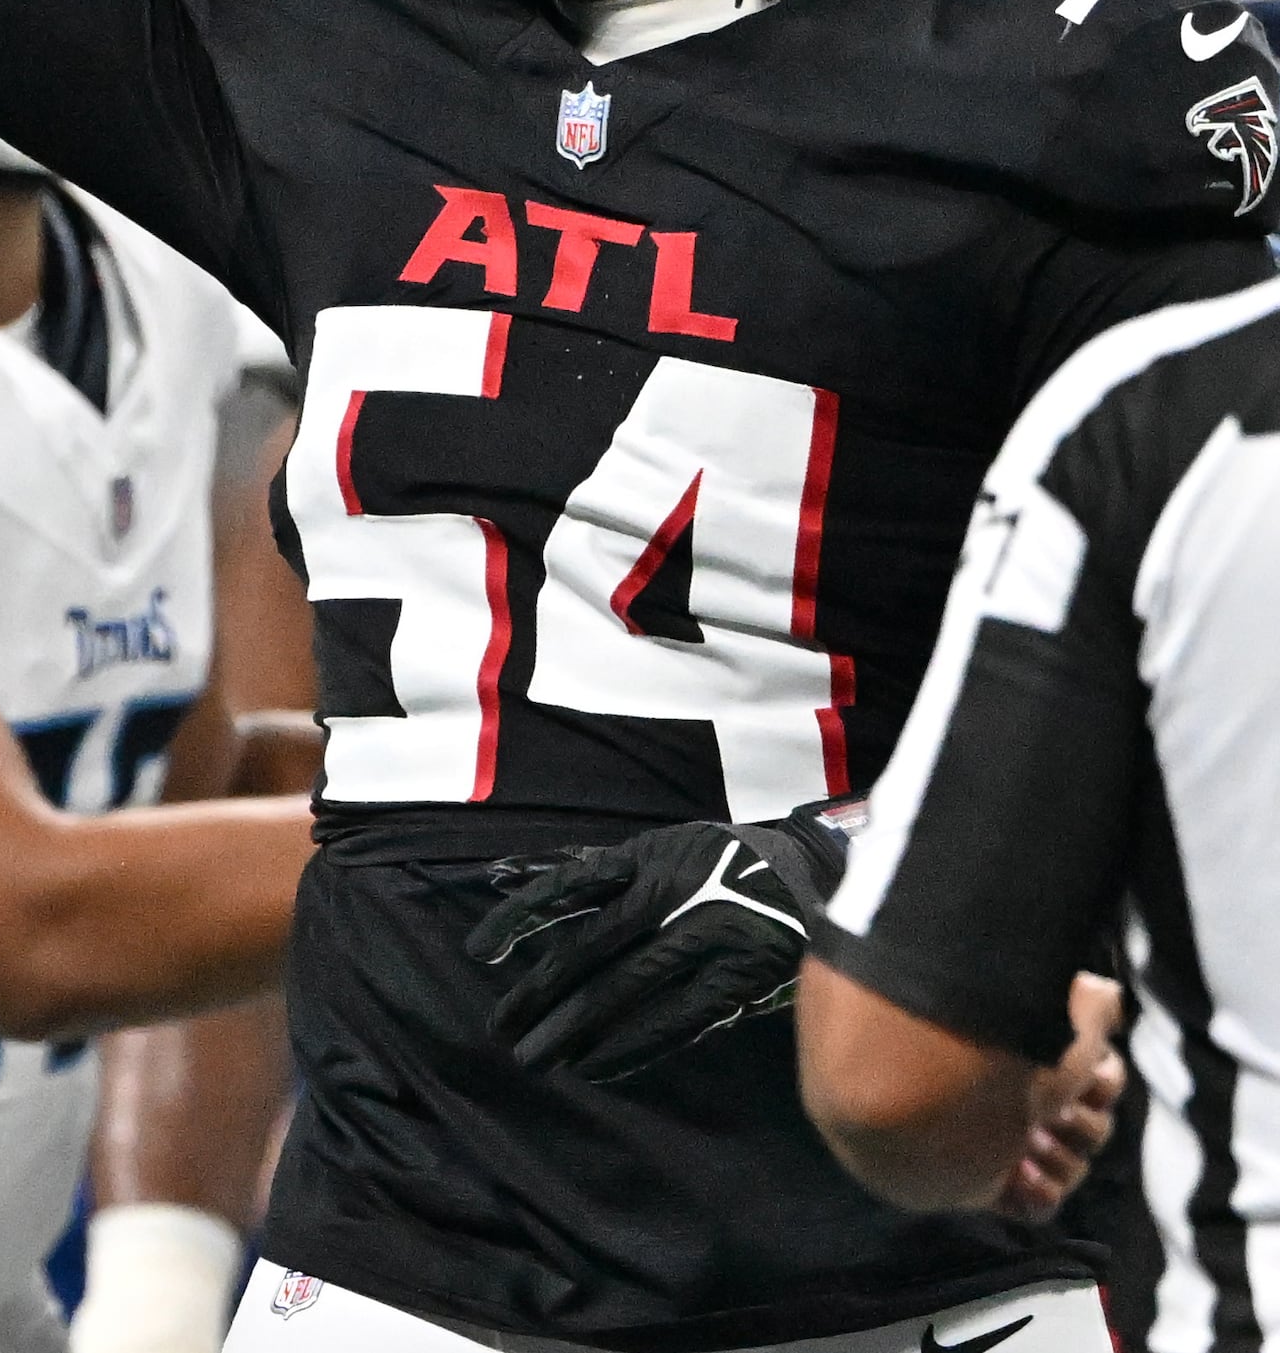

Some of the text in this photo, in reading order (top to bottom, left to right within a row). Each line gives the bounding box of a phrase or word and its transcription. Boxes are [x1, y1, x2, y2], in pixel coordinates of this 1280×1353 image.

[564, 122, 598, 154] NFL
[397, 183, 739, 343] ATL
[285, 304, 857, 825] 54
